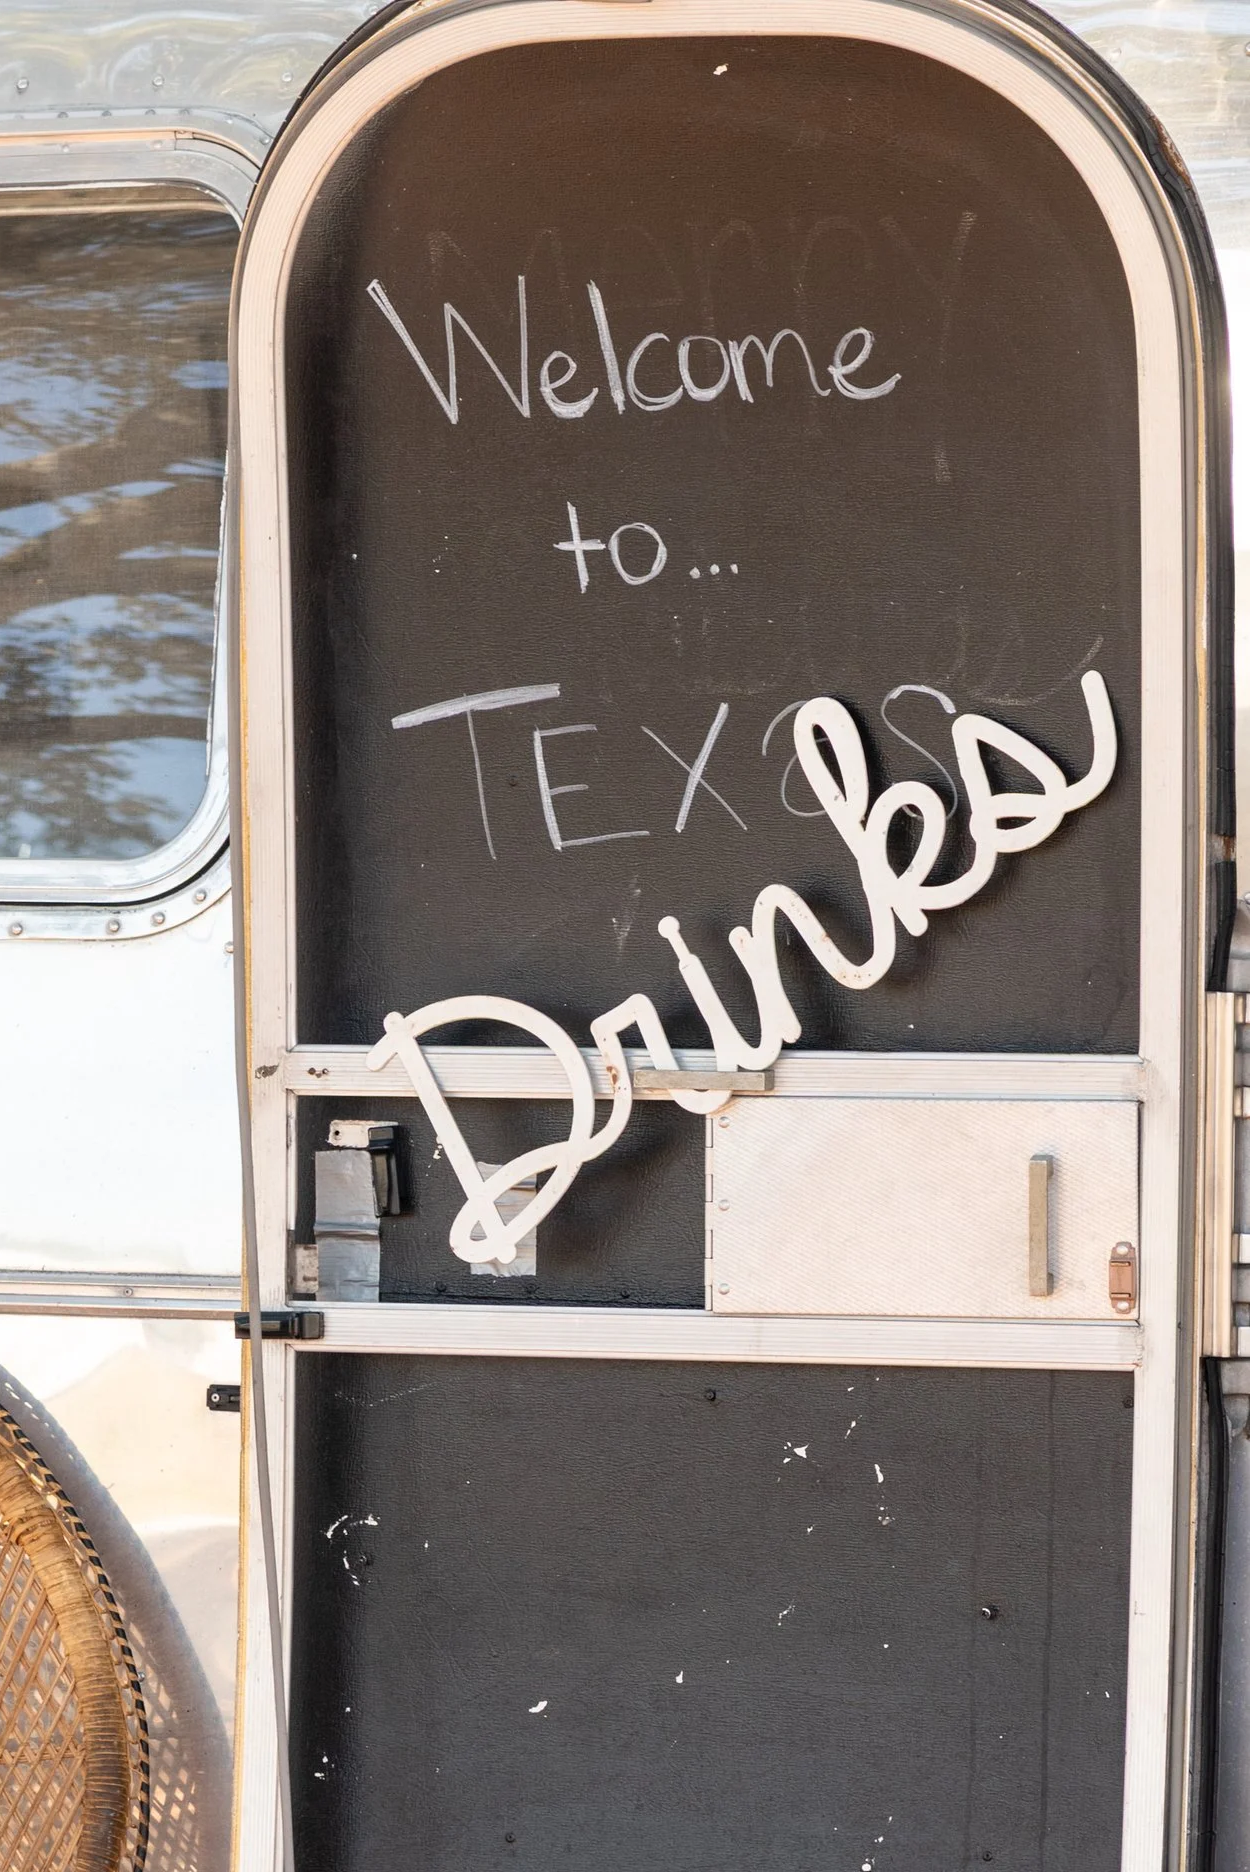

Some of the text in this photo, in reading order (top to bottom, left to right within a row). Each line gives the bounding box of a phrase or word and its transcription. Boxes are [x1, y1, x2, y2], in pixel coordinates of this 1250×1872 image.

[365, 274, 903, 426] Welcome
[552, 500, 739, 595] to...
[365, 669, 1118, 1266] Drinks
